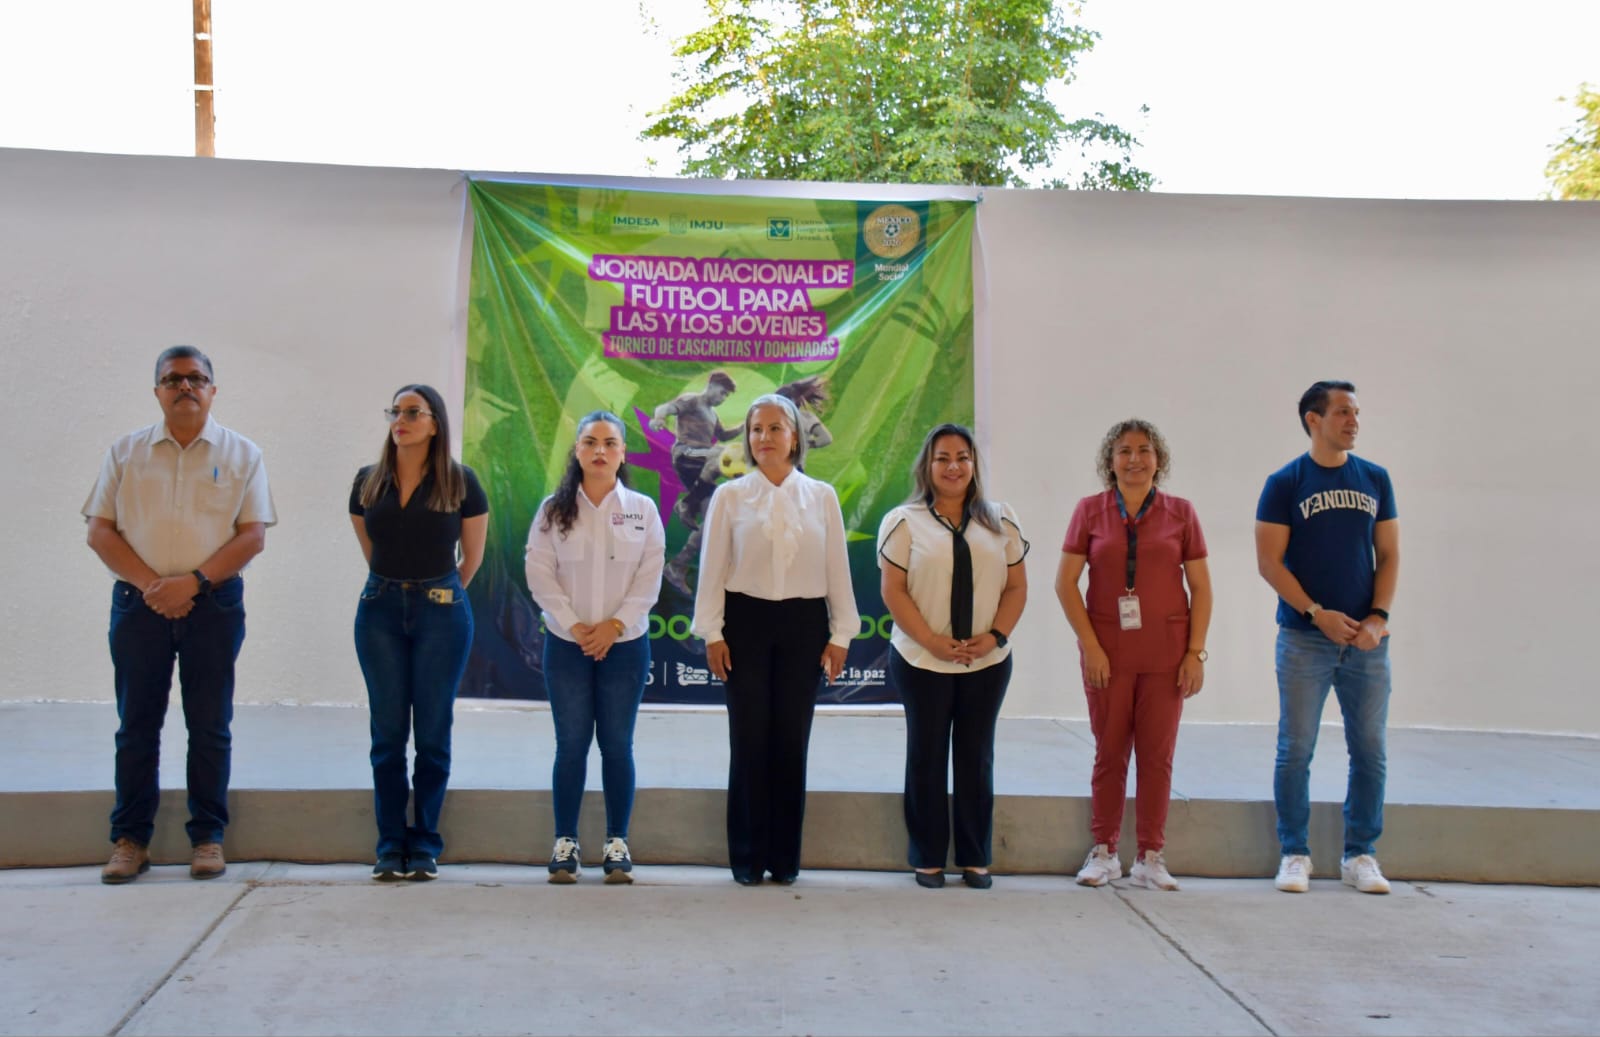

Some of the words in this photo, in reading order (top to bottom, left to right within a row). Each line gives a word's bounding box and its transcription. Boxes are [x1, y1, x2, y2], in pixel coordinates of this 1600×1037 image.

[613, 215, 660, 227] IMDESA
[689, 219, 724, 231] IMJU
[595, 258, 699, 283] JORNADA
[703, 262, 819, 285] NACIONAL
[822, 264, 850, 284] DE
[874, 263, 909, 273] Mundial
[631, 279, 734, 312] FÚTBOL
[739, 287, 809, 313] PARA
[617, 310, 658, 332] LAS
[661, 312, 677, 333] Y
[681, 313, 724, 335] LOS
[727, 311, 823, 337] JÓVENES
[609, 335, 656, 354] TORNEO
[659, 338, 675, 355] DE
[677, 338, 751, 358] CASCARITAS
[754, 341, 763, 358] Y
[764, 339, 835, 359] DOMINADAS
[849, 666, 862, 679] la
[863, 669, 886, 681] paz
